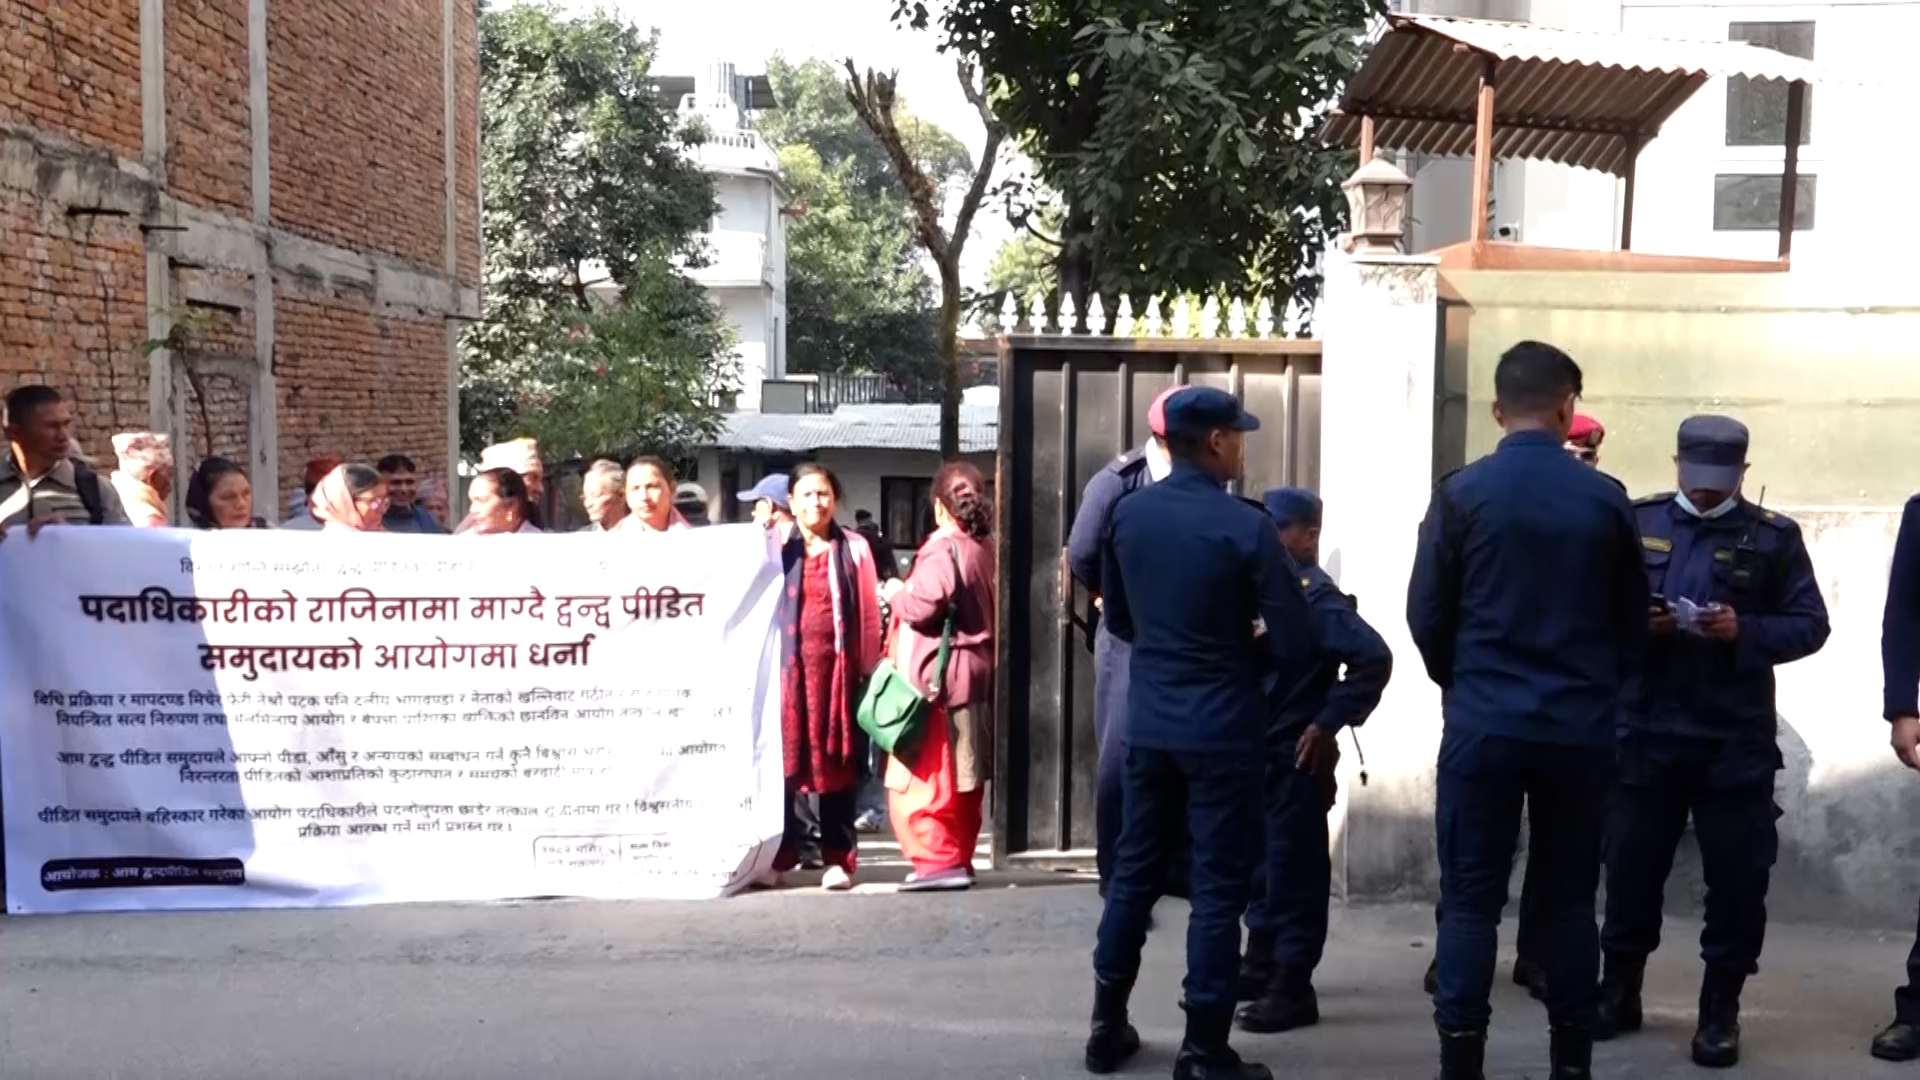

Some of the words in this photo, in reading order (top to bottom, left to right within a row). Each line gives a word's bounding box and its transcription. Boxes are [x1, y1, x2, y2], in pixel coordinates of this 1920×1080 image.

[79, 587, 297, 622] पदाधिकारीको
[307, 588, 460, 622] राजिनामा
[469, 586, 546, 619] माग्दै
[622, 586, 705, 619] पीडित
[198, 638, 363, 681] समुदायको
[375, 638, 517, 669] आयोगमा
[530, 634, 595, 666] धर्ना
[119, 750, 162, 765] पीडित
